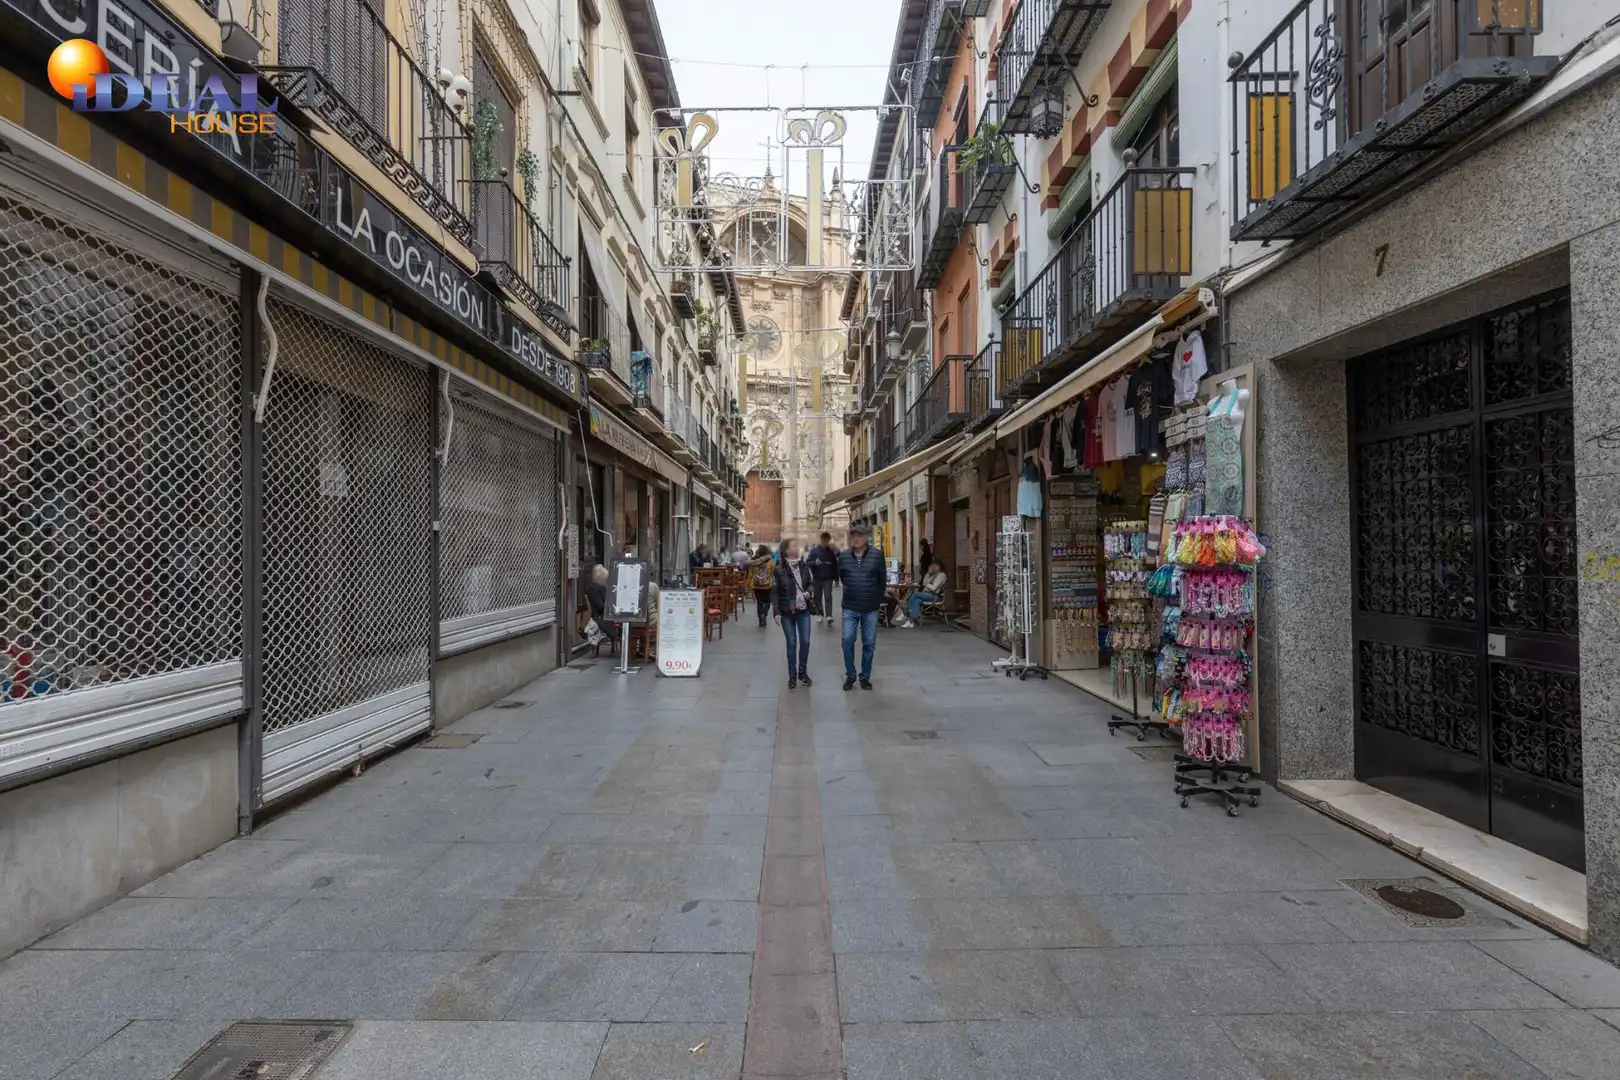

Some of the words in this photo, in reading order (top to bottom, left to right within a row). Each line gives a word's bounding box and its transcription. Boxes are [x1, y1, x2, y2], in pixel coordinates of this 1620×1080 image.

[337, 187, 376, 253] LA
[385, 230, 484, 329] OCASIÓN
[1376, 243, 1389, 276] 7
[511, 326, 553, 375] DESDE
[554, 363, 576, 394] 1908
